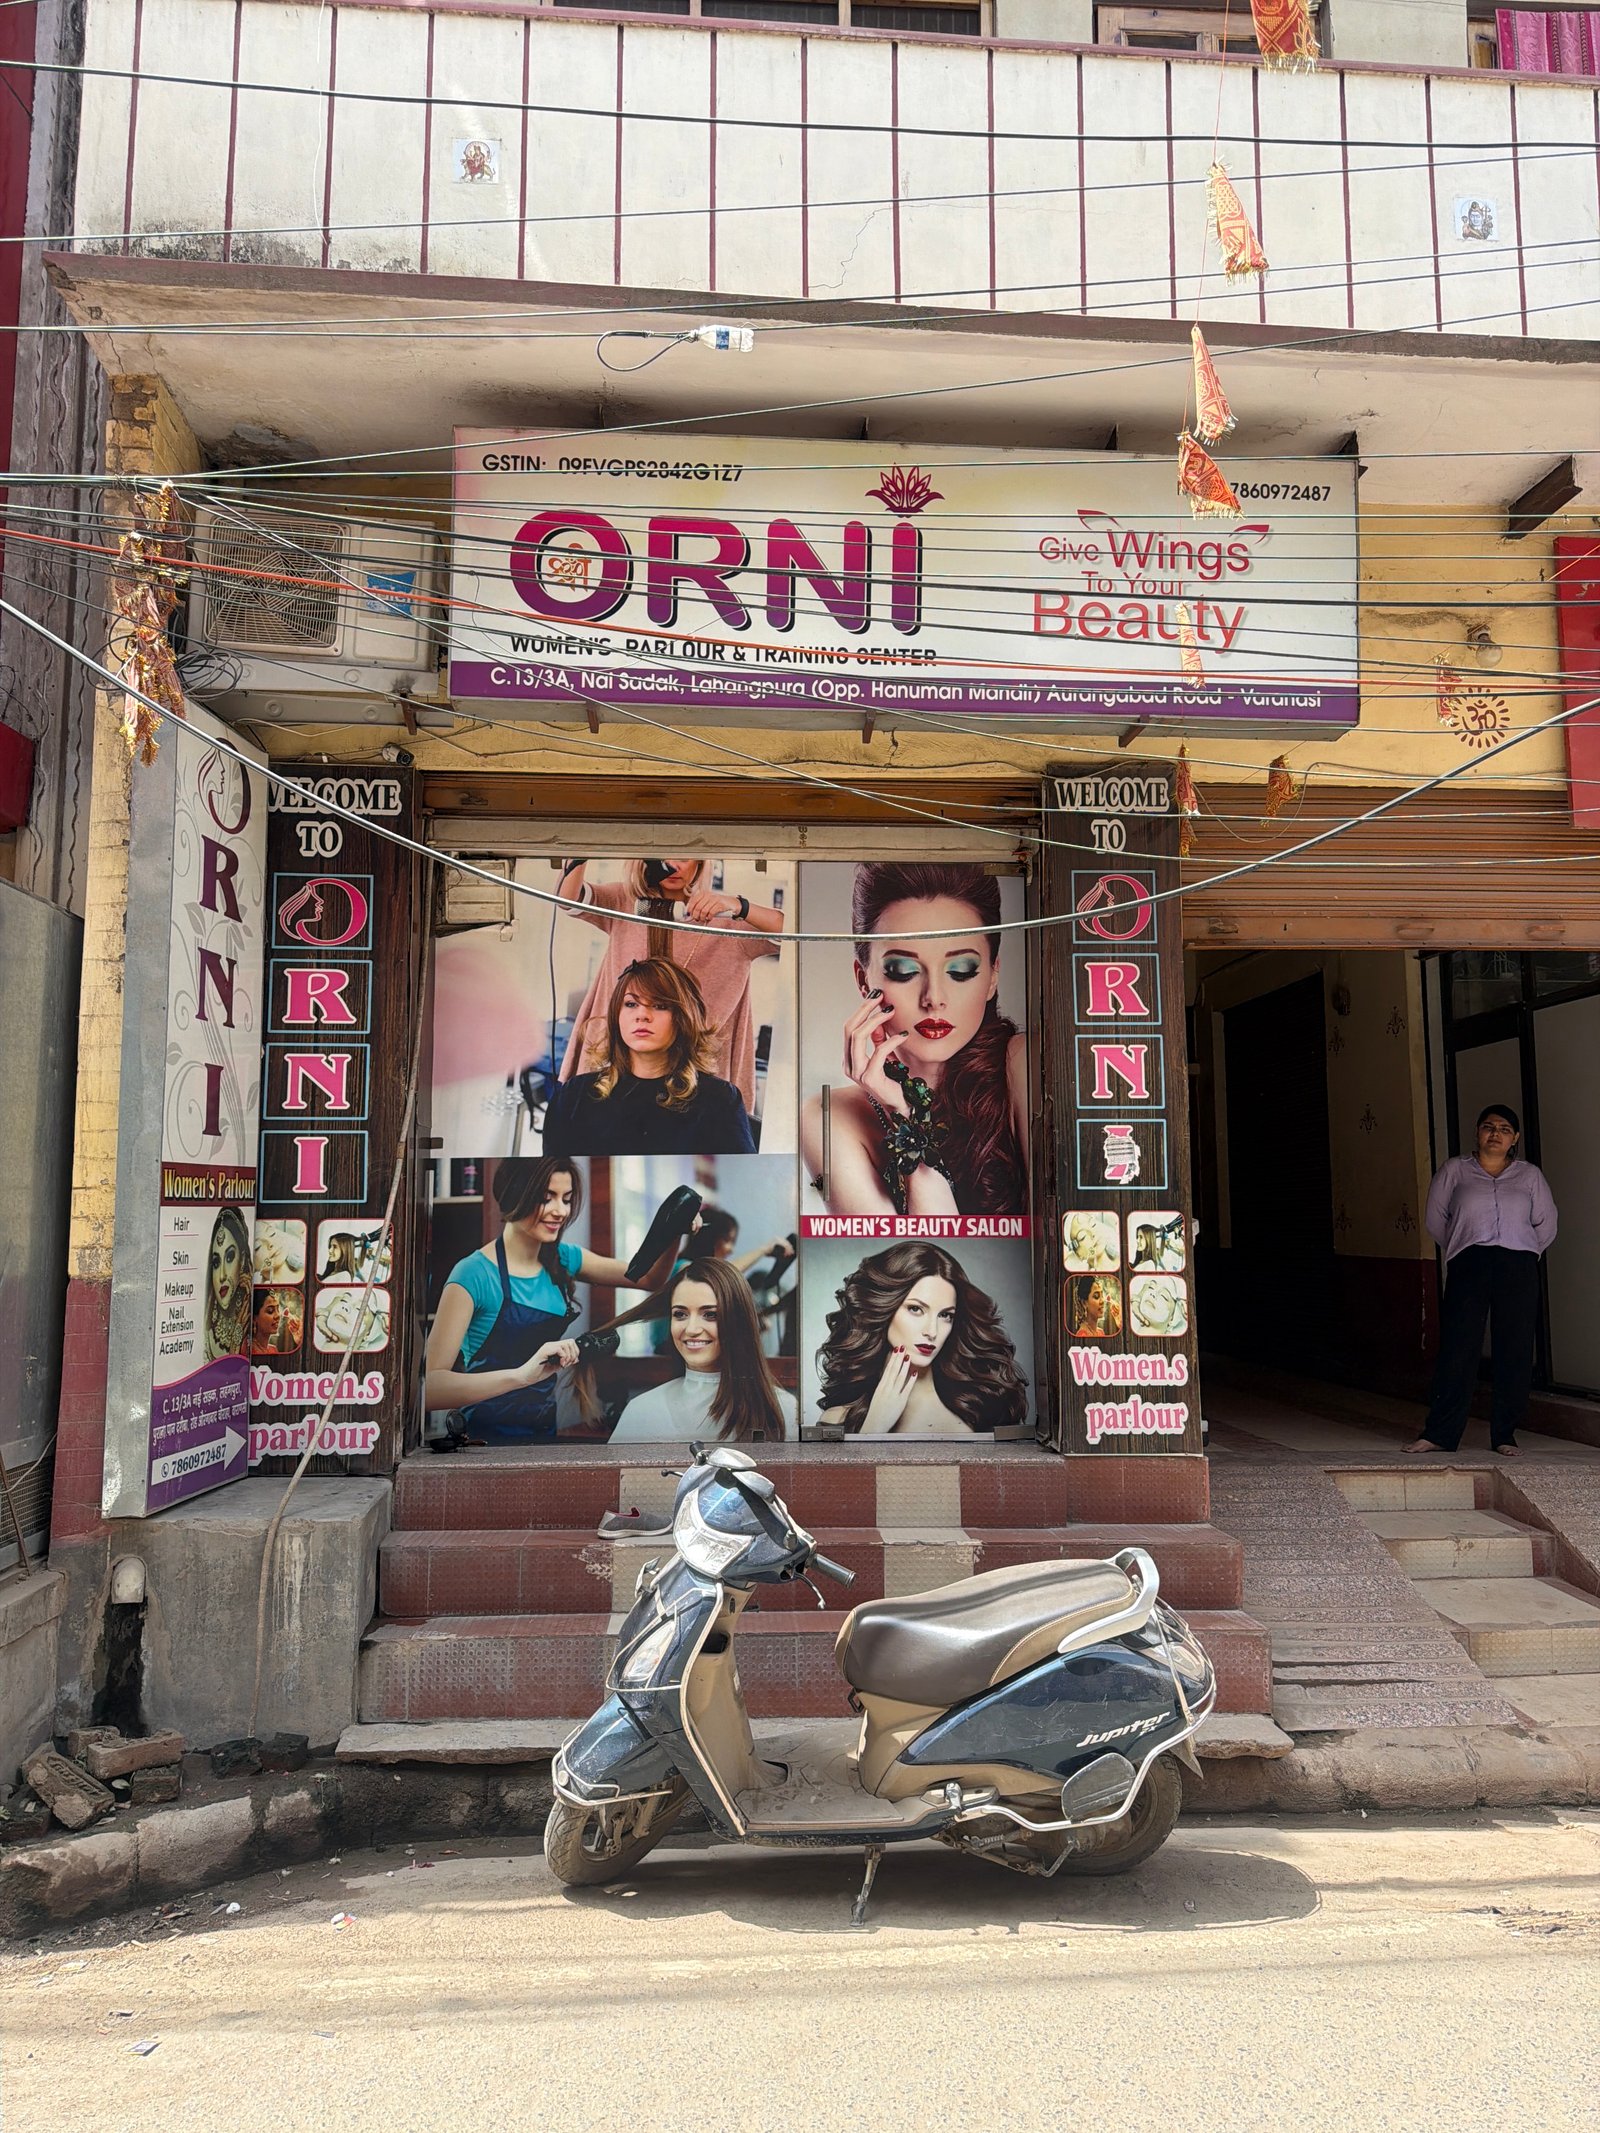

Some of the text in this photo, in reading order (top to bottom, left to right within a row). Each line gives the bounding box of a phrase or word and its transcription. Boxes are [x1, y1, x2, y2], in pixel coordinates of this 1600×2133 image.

[1038, 529, 1250, 581] Give Wings
[509, 509, 923, 636] ORNI
[1081, 570, 1187, 596] To Your
[1033, 588, 1246, 655] Beauty
[511, 635, 612, 656] WOMEN'S
[732, 644, 747, 662] &
[755, 643, 850, 665] TRAINING
[856, 646, 938, 667] CENTER
[581, 670, 614, 690] Nai
[618, 672, 686, 695] Sadak,
[691, 674, 806, 700] Lahangpura
[811, 679, 865, 701] (Opp.
[871, 681, 963, 701] Hanuman
[968, 683, 1041, 704] Mandir)
[1046, 684, 1167, 708] Aurangabad
[1173, 686, 1222, 705] Road
[1240, 688, 1321, 708] Varanasi
[1056, 779, 1168, 810] WELCOME
[298, 823, 341, 856] TO
[1092, 820, 1124, 852] TO
[163, 1168, 256, 1200] Women's Parlour
[173, 1216, 190, 1232] Hair
[809, 1217, 1023, 1237] WOMEN'S BEAUTY SALON
[172, 1250, 190, 1266] Skin
[164, 1282, 194, 1298] Makeup
[160, 1319, 194, 1335] Extension
[168, 1305, 185, 1321] Nail
[159, 1337, 194, 1356] Academy
[1070, 1349, 1187, 1384] Women.s
[1086, 1397, 1187, 1441] parlour
[248, 1417, 379, 1464] parlour
[171, 1443, 227, 1476] 7860972487
